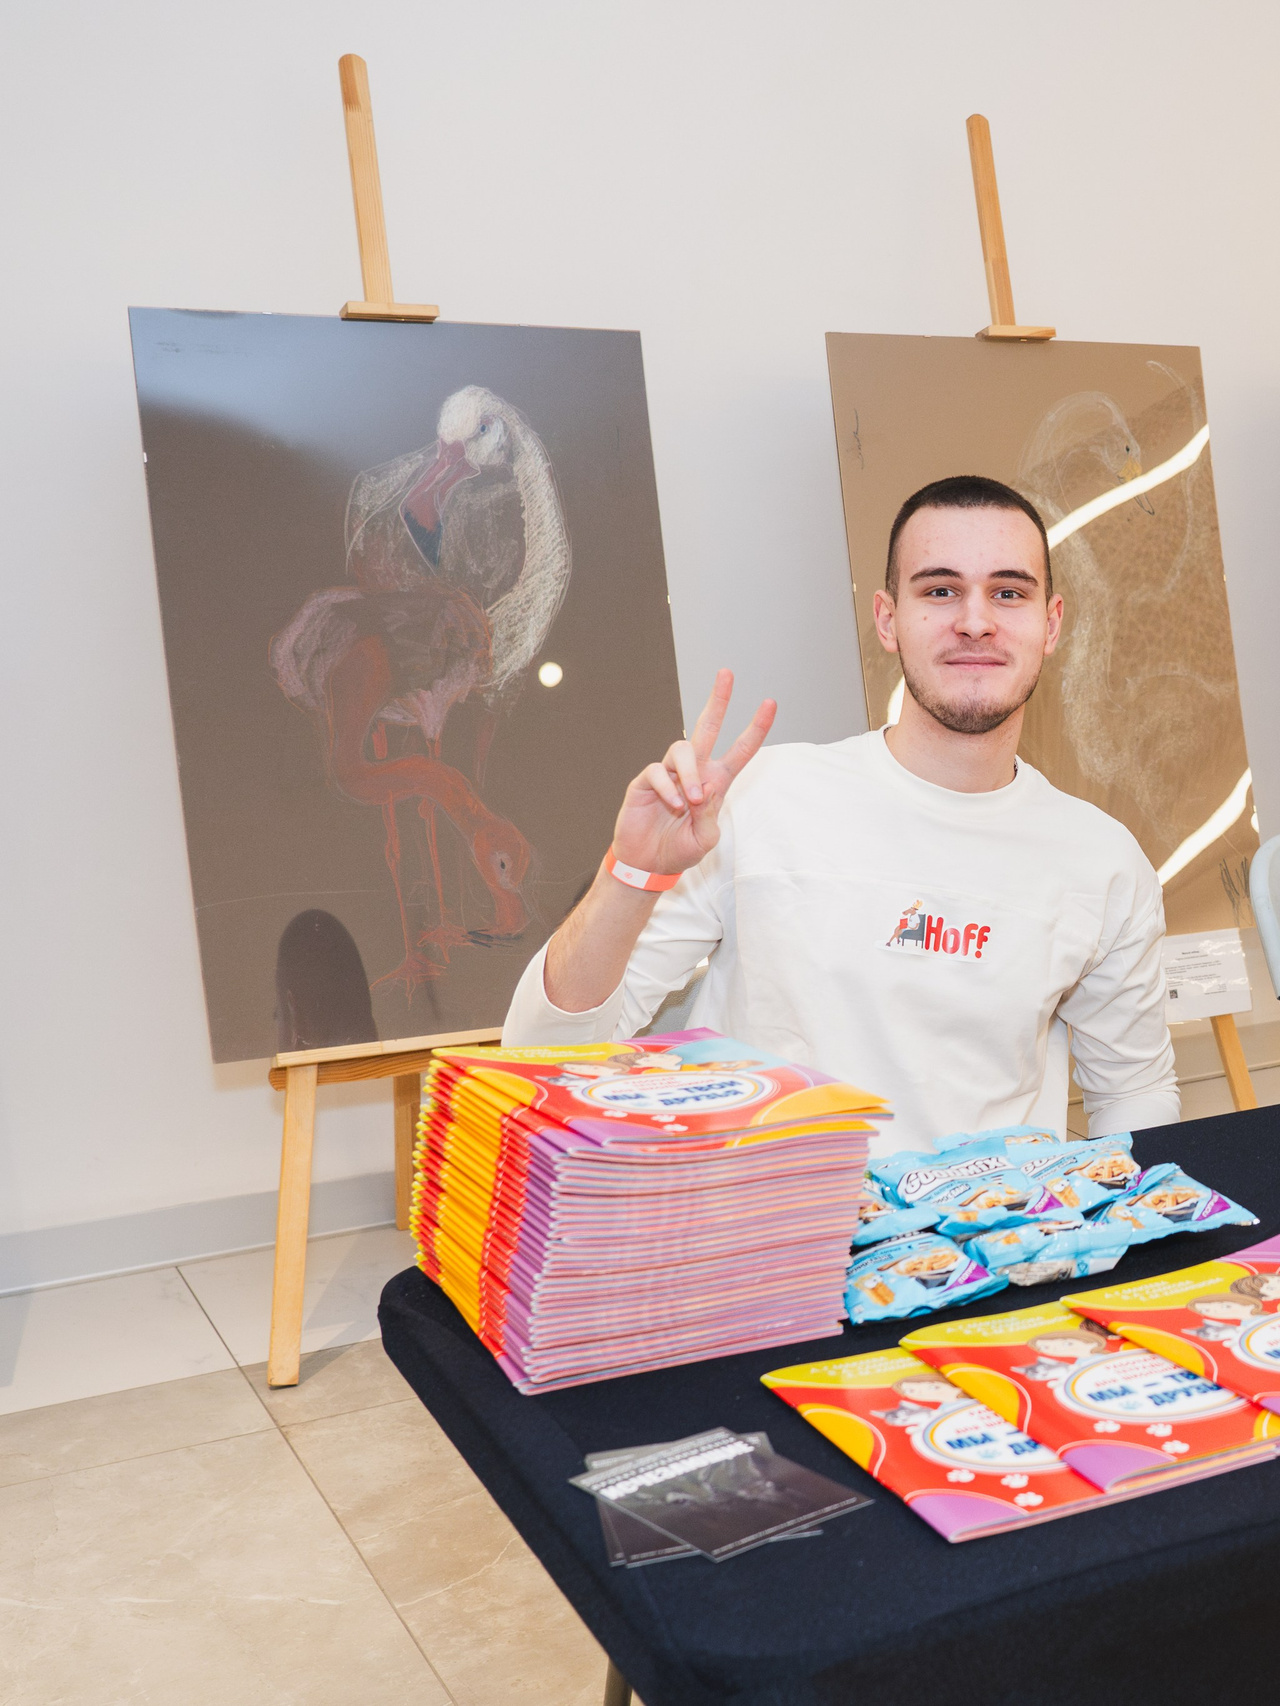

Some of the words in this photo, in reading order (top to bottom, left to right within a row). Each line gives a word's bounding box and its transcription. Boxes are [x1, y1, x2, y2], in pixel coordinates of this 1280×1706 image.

[925, 915, 991, 958] Hoff
[1087, 1385, 1136, 1401] МЫ
[1163, 1370, 1201, 1383] ТВ
[945, 1432, 994, 1449] МЫ
